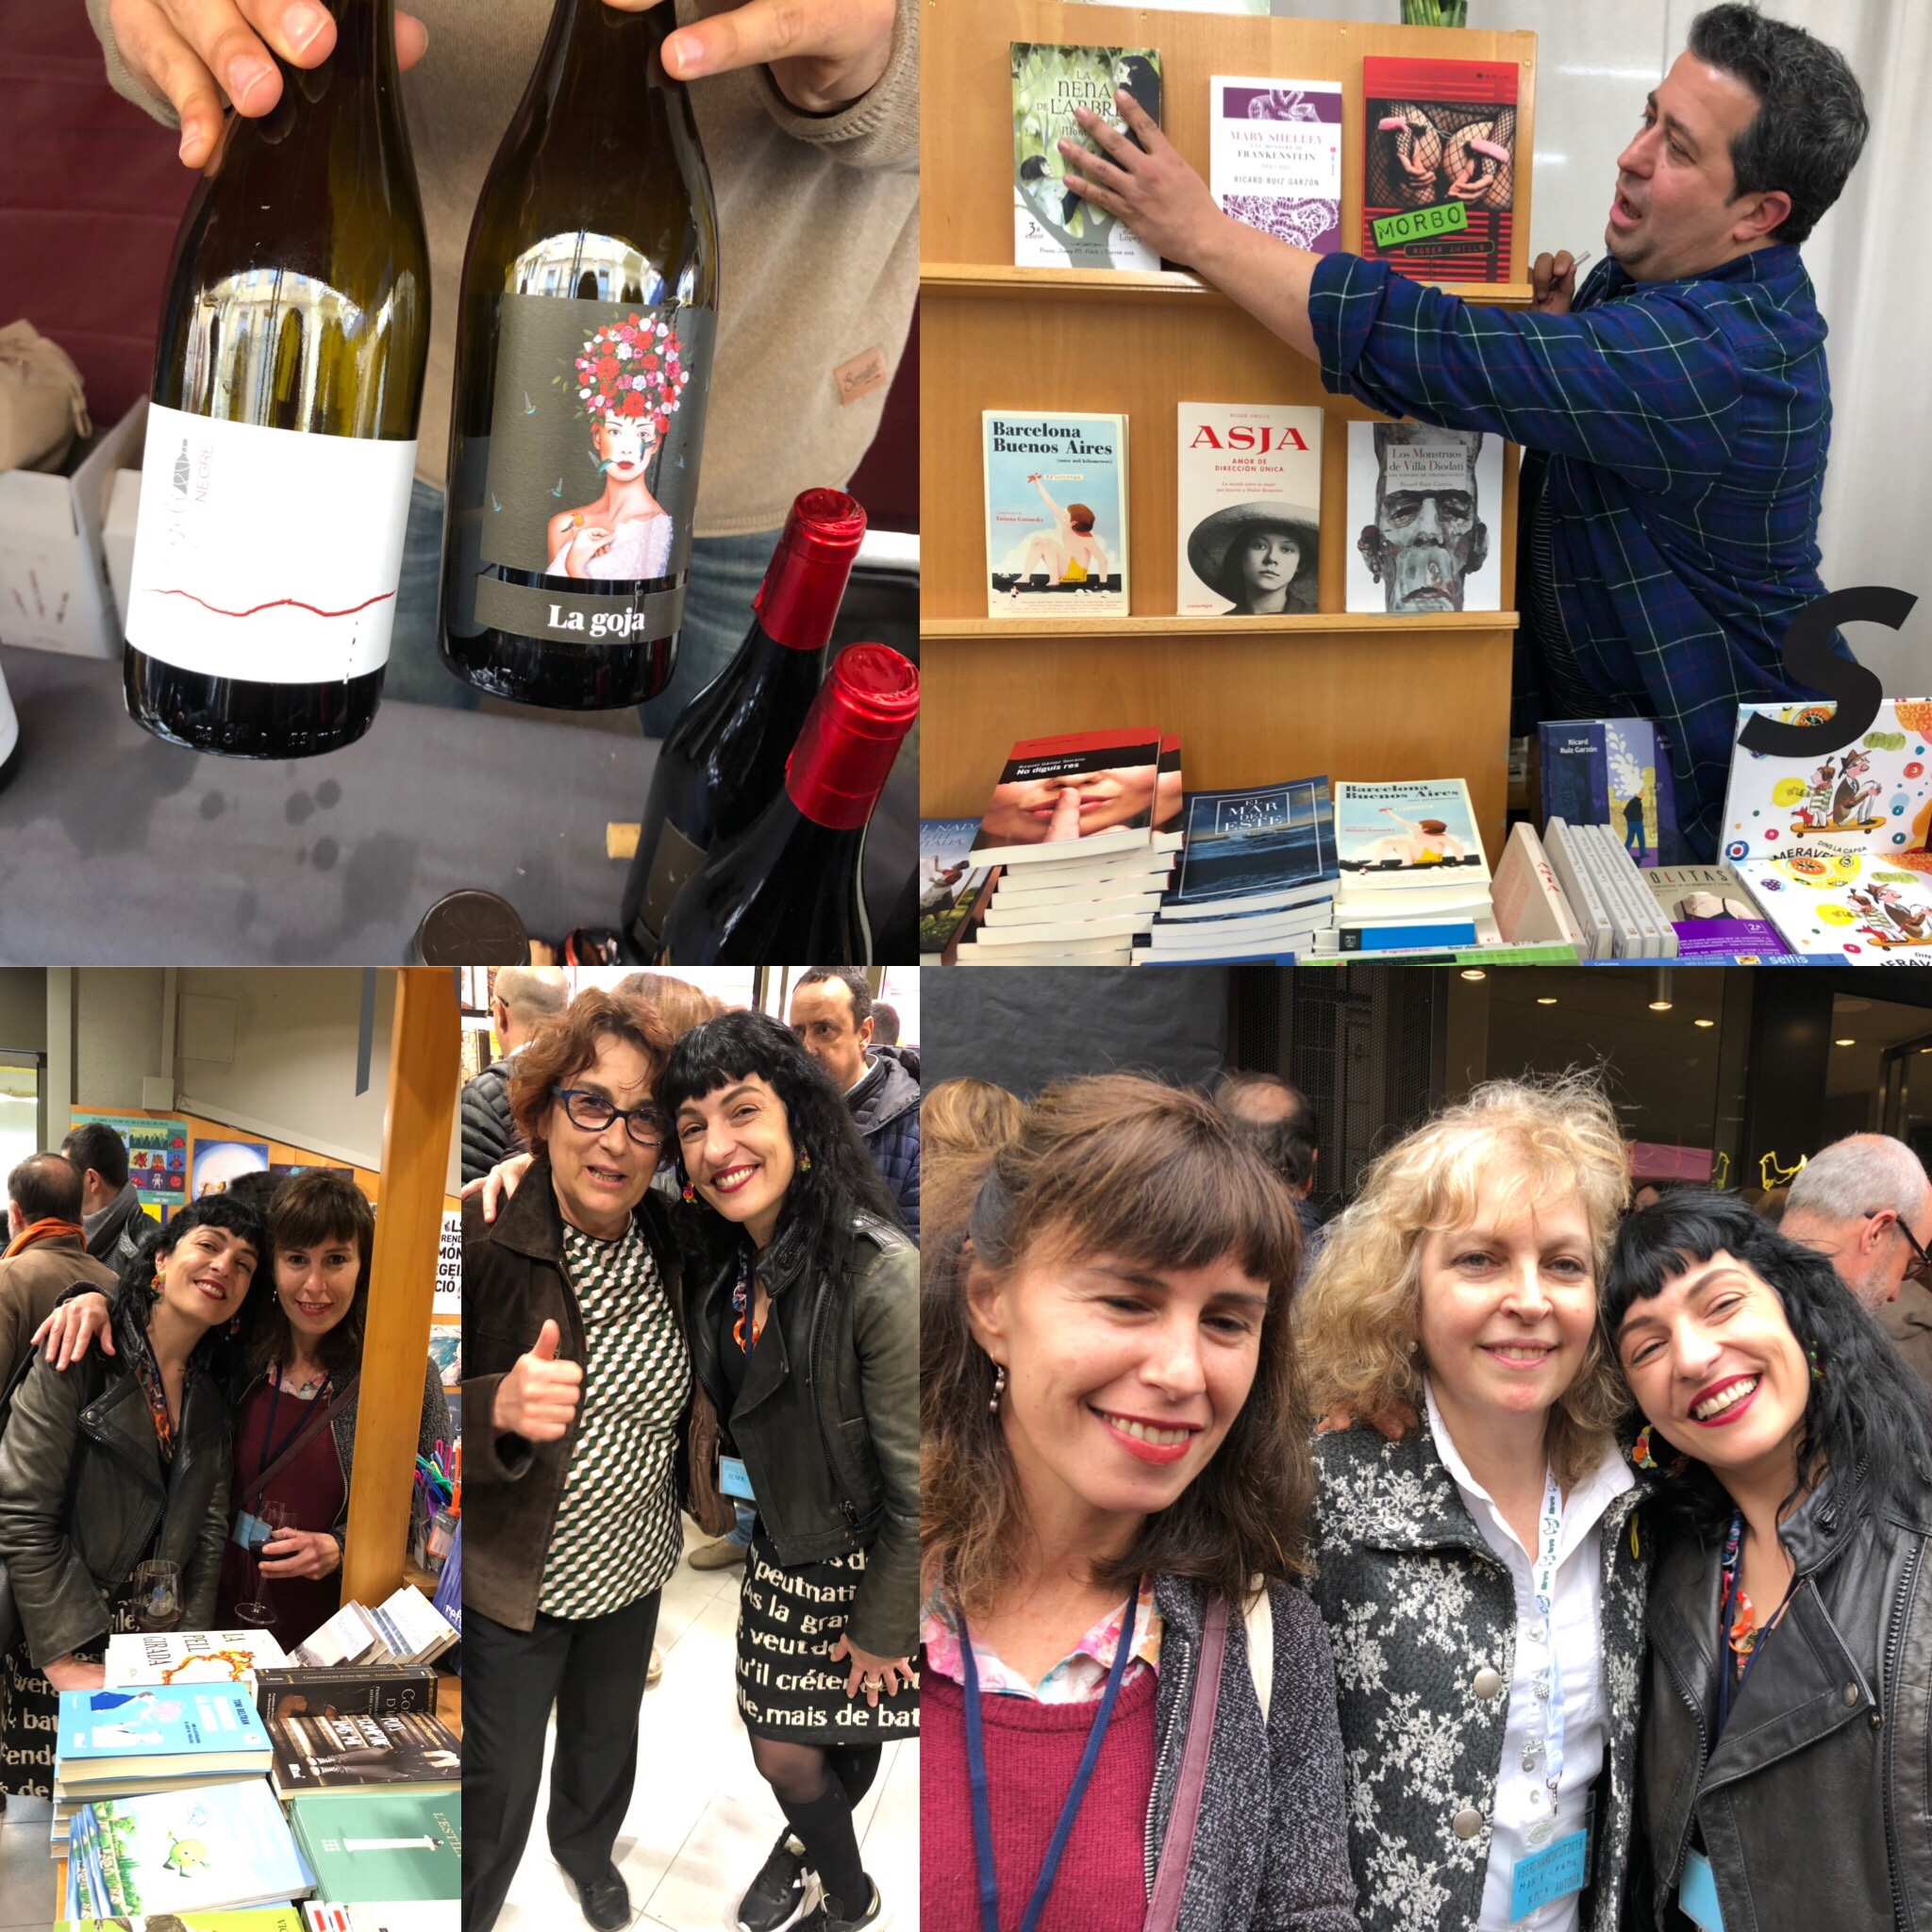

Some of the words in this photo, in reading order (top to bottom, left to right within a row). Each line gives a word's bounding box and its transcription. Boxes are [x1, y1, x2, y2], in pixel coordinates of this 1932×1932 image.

[1077, 71, 1091, 80] LA
[1058, 80, 1112, 98] NENA
[1037, 103, 1049, 111] DE
[1231, 131, 1263, 141] MARY
[1269, 133, 1323, 144] SHELLEY
[1238, 150, 1316, 160] FRANKENSTEIN
[1234, 175, 1263, 184] RICARD
[1267, 176, 1285, 186] RUIZ
[1377, 206, 1460, 240] MORBO
[992, 421, 1081, 438] Barcelona
[993, 438, 1058, 454] Buenos
[1066, 440, 1113, 456] Aires
[1189, 425, 1310, 455] ASJA
[1392, 448, 1409, 458] Los
[1413, 448, 1462, 458] Monstruos
[1389, 461, 1401, 471] de
[1404, 460, 1426, 471] Villa
[1429, 460, 1464, 471] Diodati
[195, 444, 215, 503] NEGRE
[548, 605, 585, 631] La
[590, 608, 645, 637] goja
[1736, 586, 1919, 758] S
[1032, 764, 1061, 774] diguis
[1228, 802, 1278, 816] MAR
[1224, 815, 1282, 831] ESTE
[1818, 840, 1832, 849] DINS
[1842, 845, 1868, 855] CAPSA
[1769, 955, 1808, 965] selfis
[768, 1594, 791, 1623] la
[183, 1634, 210, 1653] PELL
[223, 1633, 246, 1642] LA
[143, 1636, 172, 1667] GIRADA
[835, 1703, 870, 1727] de
[381, 1717, 407, 1732] POTS
